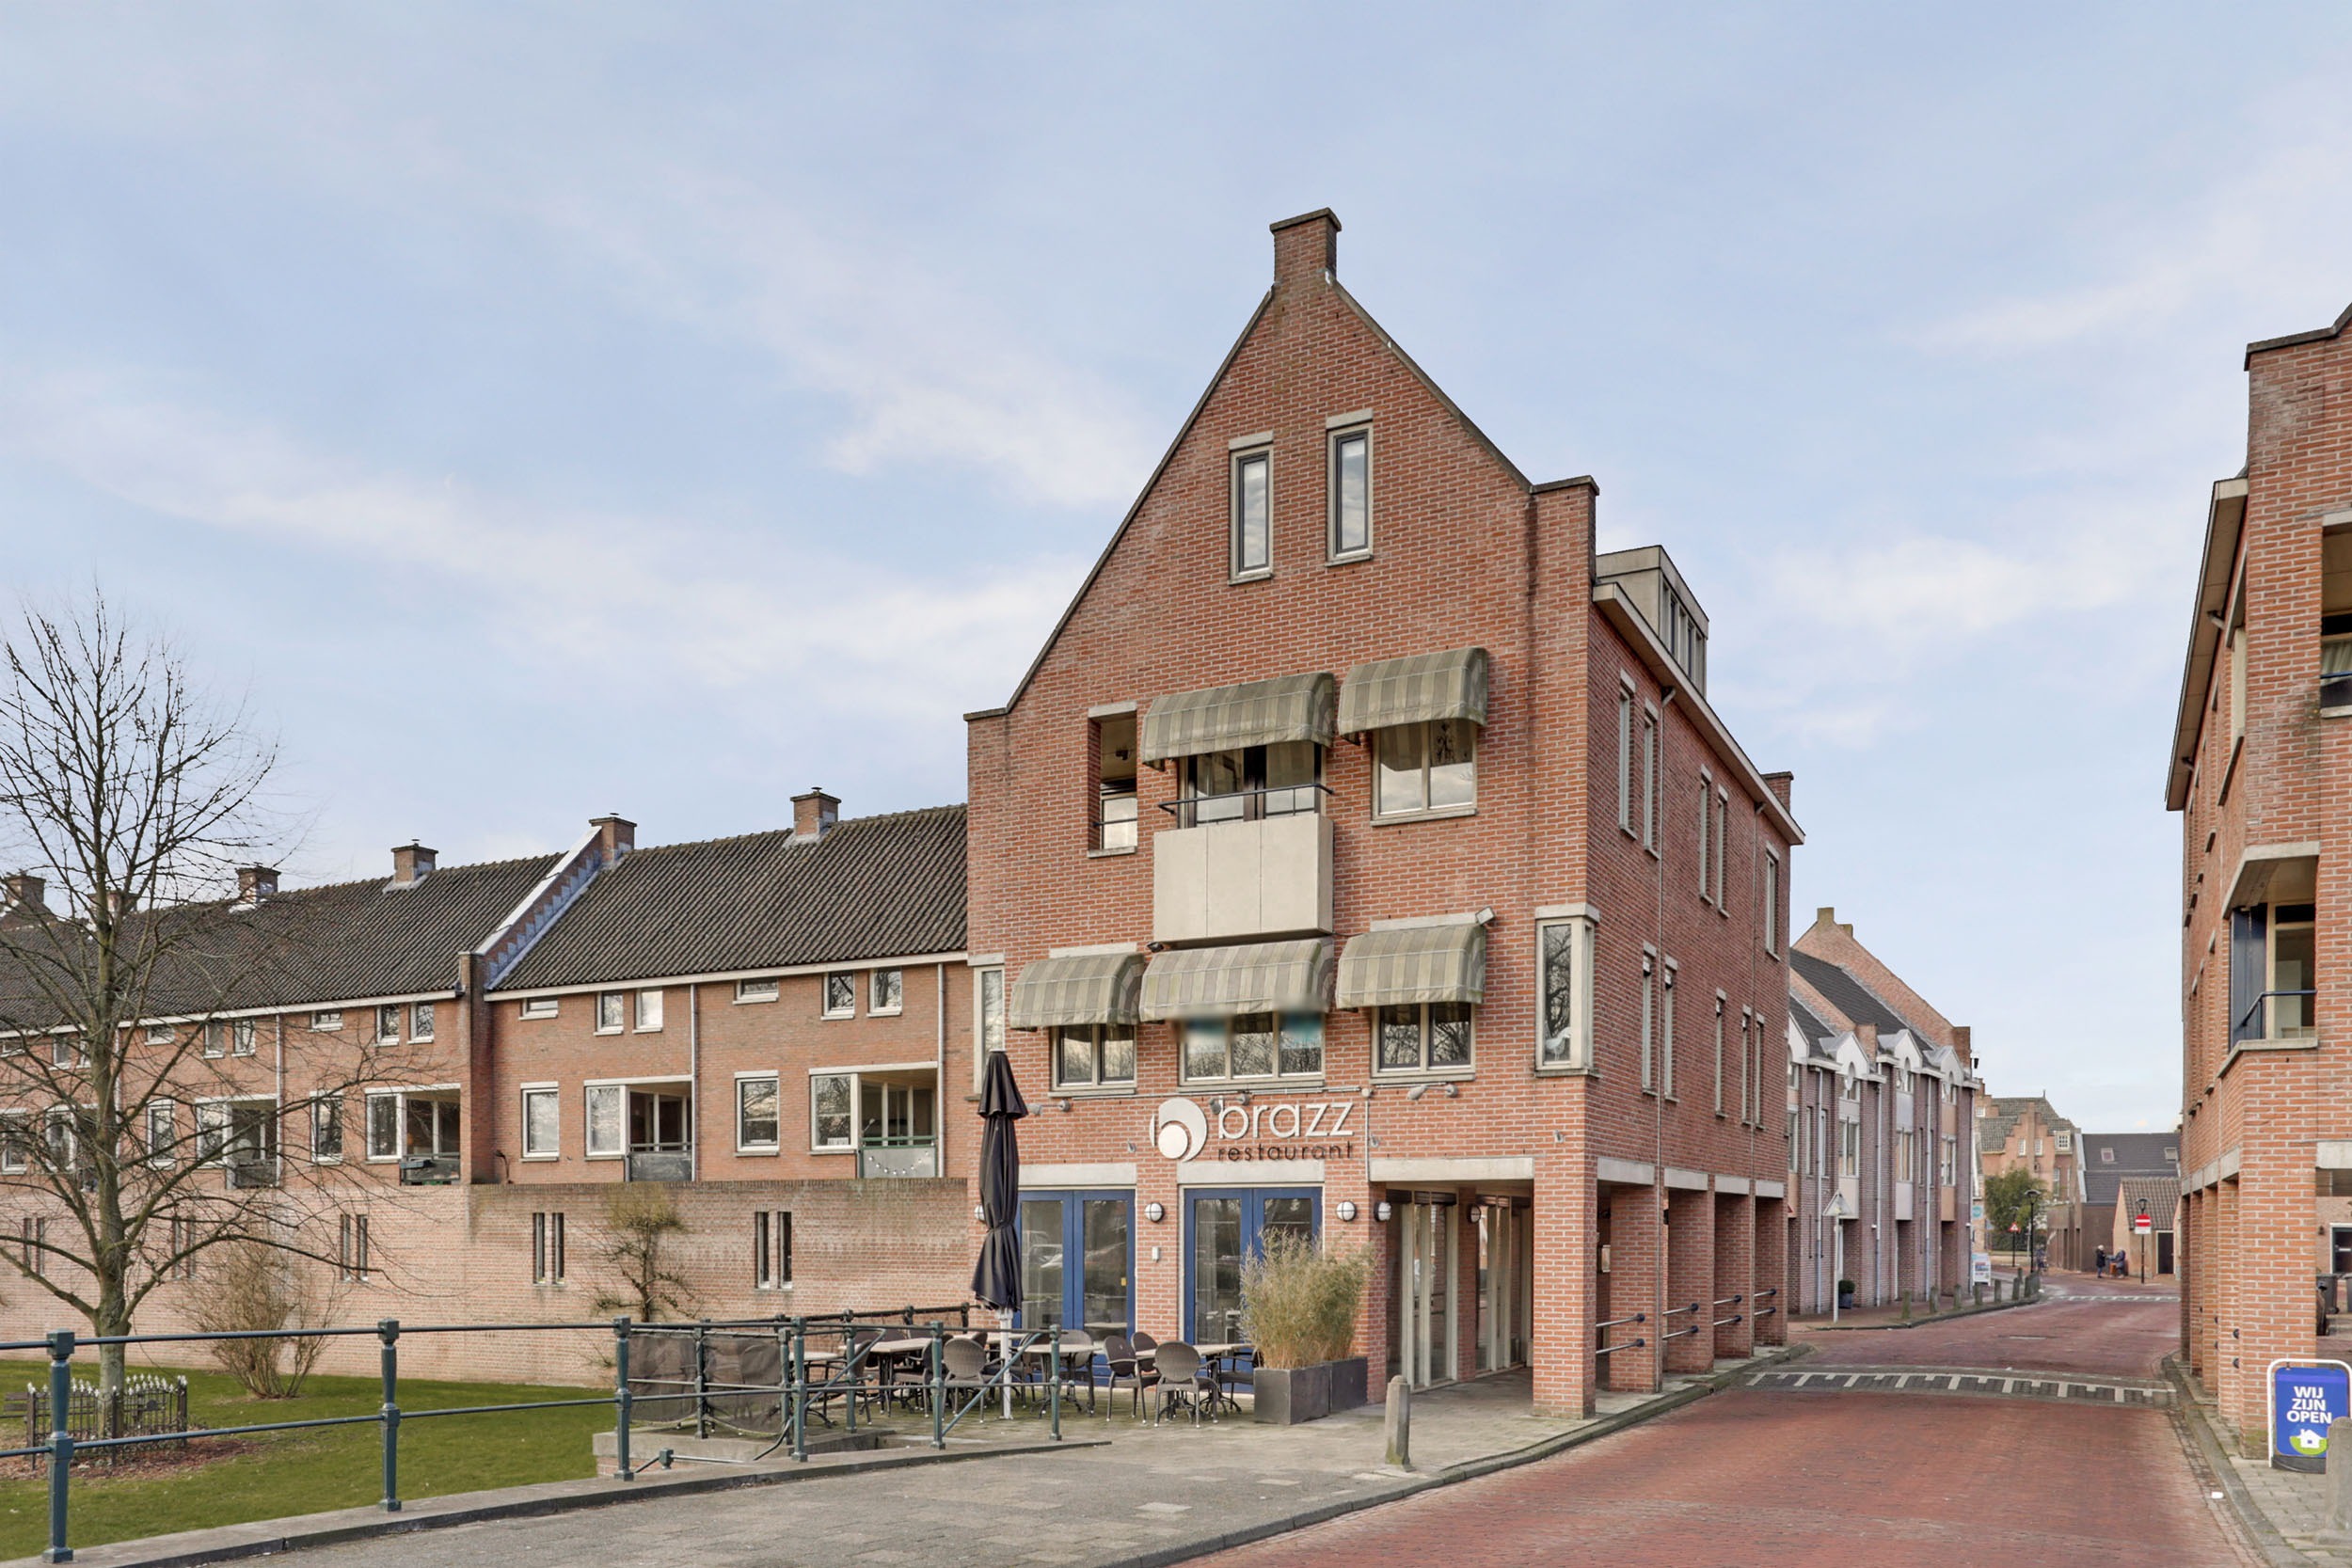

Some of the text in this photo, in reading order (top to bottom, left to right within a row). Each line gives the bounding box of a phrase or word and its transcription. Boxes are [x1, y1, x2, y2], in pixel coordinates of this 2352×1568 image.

[1218, 1096, 1354, 1140] brazz
[1218, 1141, 1354, 1162] restaurant
[2294, 1386, 2324, 1399] WIJ
[2292, 1398, 2327, 1412] ZIJN
[2286, 1410, 2332, 1424] OPEN
